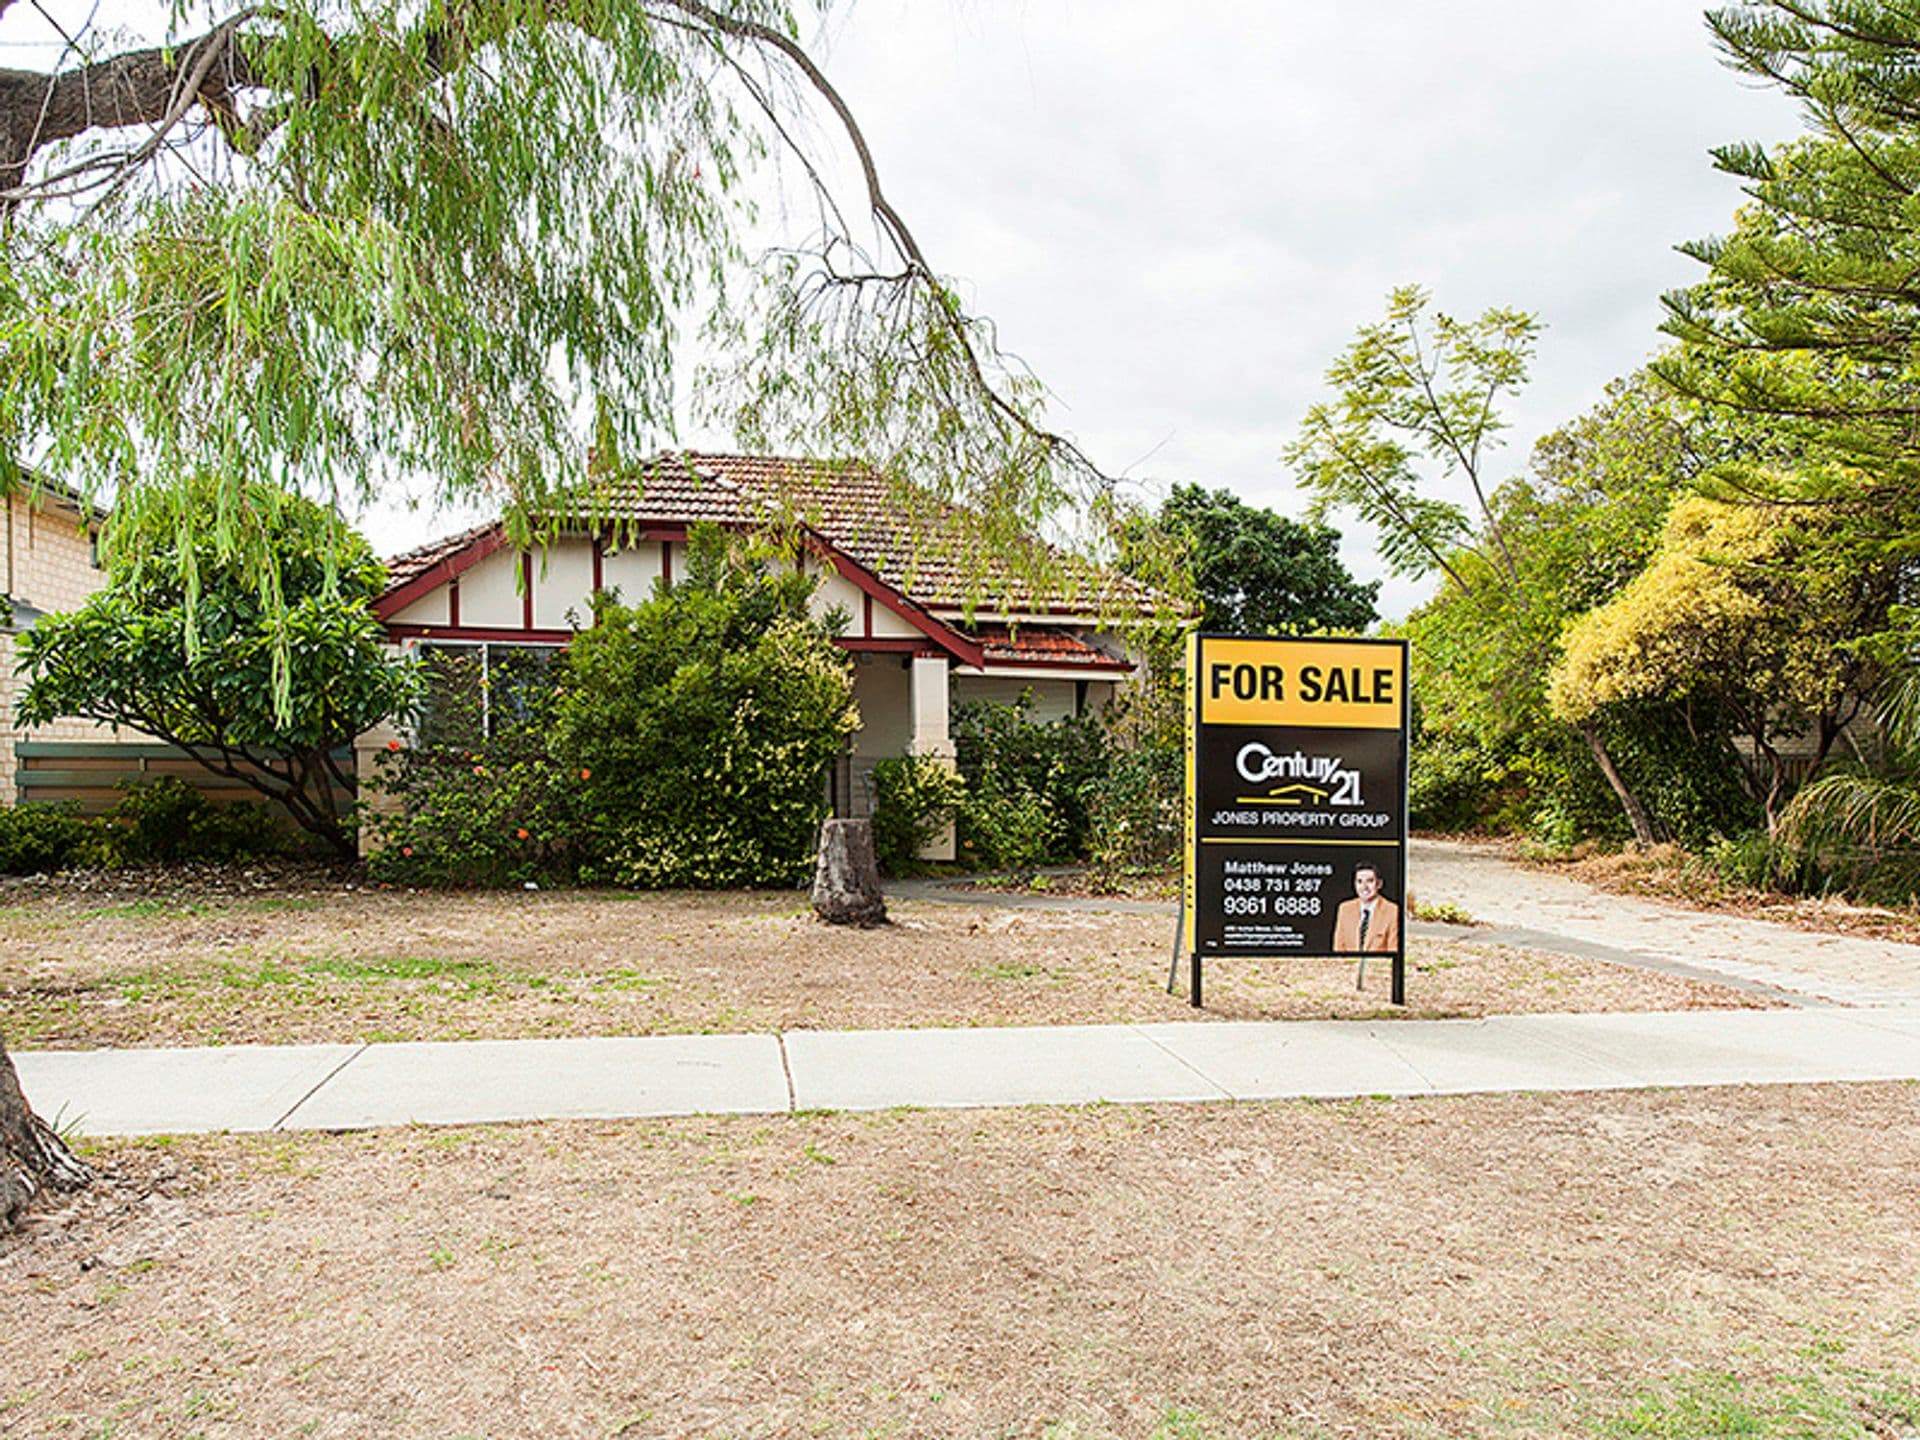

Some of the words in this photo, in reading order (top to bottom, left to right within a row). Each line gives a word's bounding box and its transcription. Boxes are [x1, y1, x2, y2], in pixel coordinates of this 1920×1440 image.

[1211, 663, 1283, 701] FOR
[1299, 666, 1393, 704] SALE
[1236, 742, 1342, 783] Century
[1212, 811, 1259, 825] JONES
[1262, 812, 1337, 826] PROPERTY
[1339, 813, 1390, 828] GROUP
[1224, 861, 1286, 874] Matthew
[1289, 863, 1333, 875] Jones
[1224, 878, 1261, 892] 0438
[1265, 879, 1290, 892] 731
[1224, 897, 1267, 914] 9361
[1274, 897, 1321, 914] 6888
